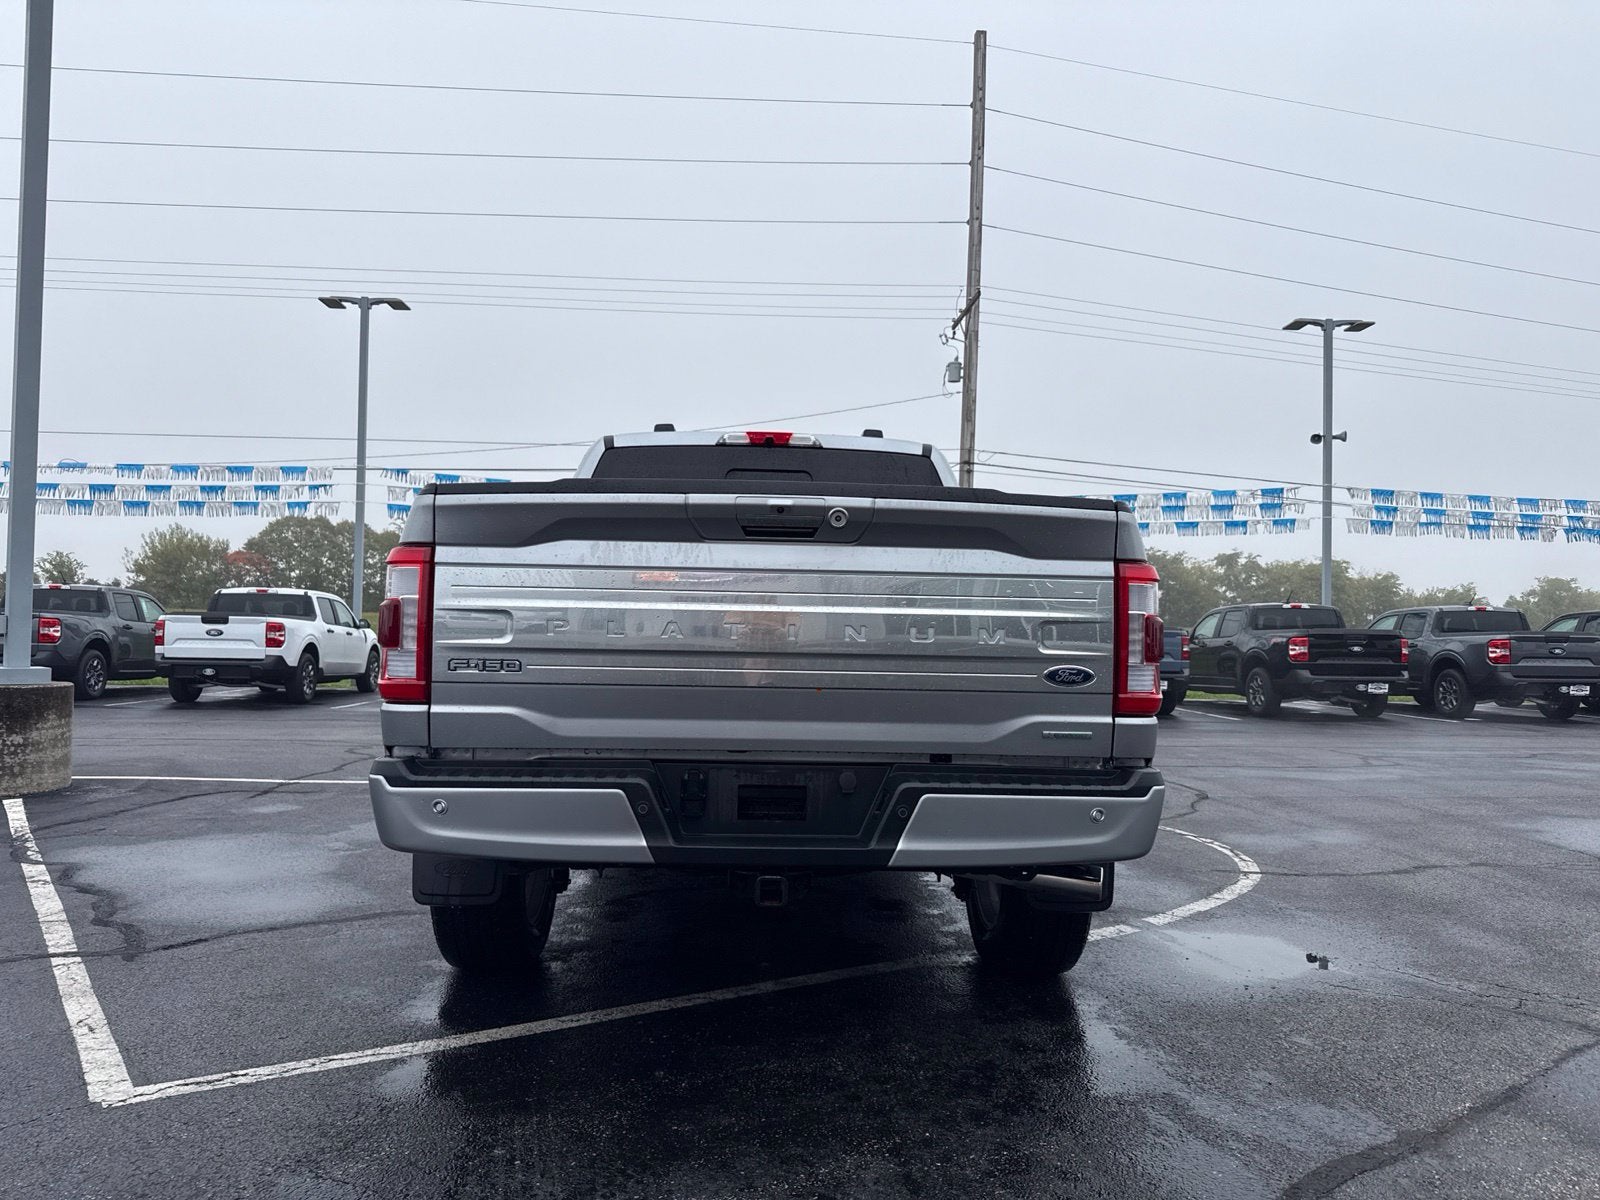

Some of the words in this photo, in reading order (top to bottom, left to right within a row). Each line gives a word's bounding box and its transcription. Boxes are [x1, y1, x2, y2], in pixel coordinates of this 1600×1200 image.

[546, 619, 1006, 645] PLATINUM
[448, 658, 522, 673] F-150
[1054, 669, 1085, 682] Ford
